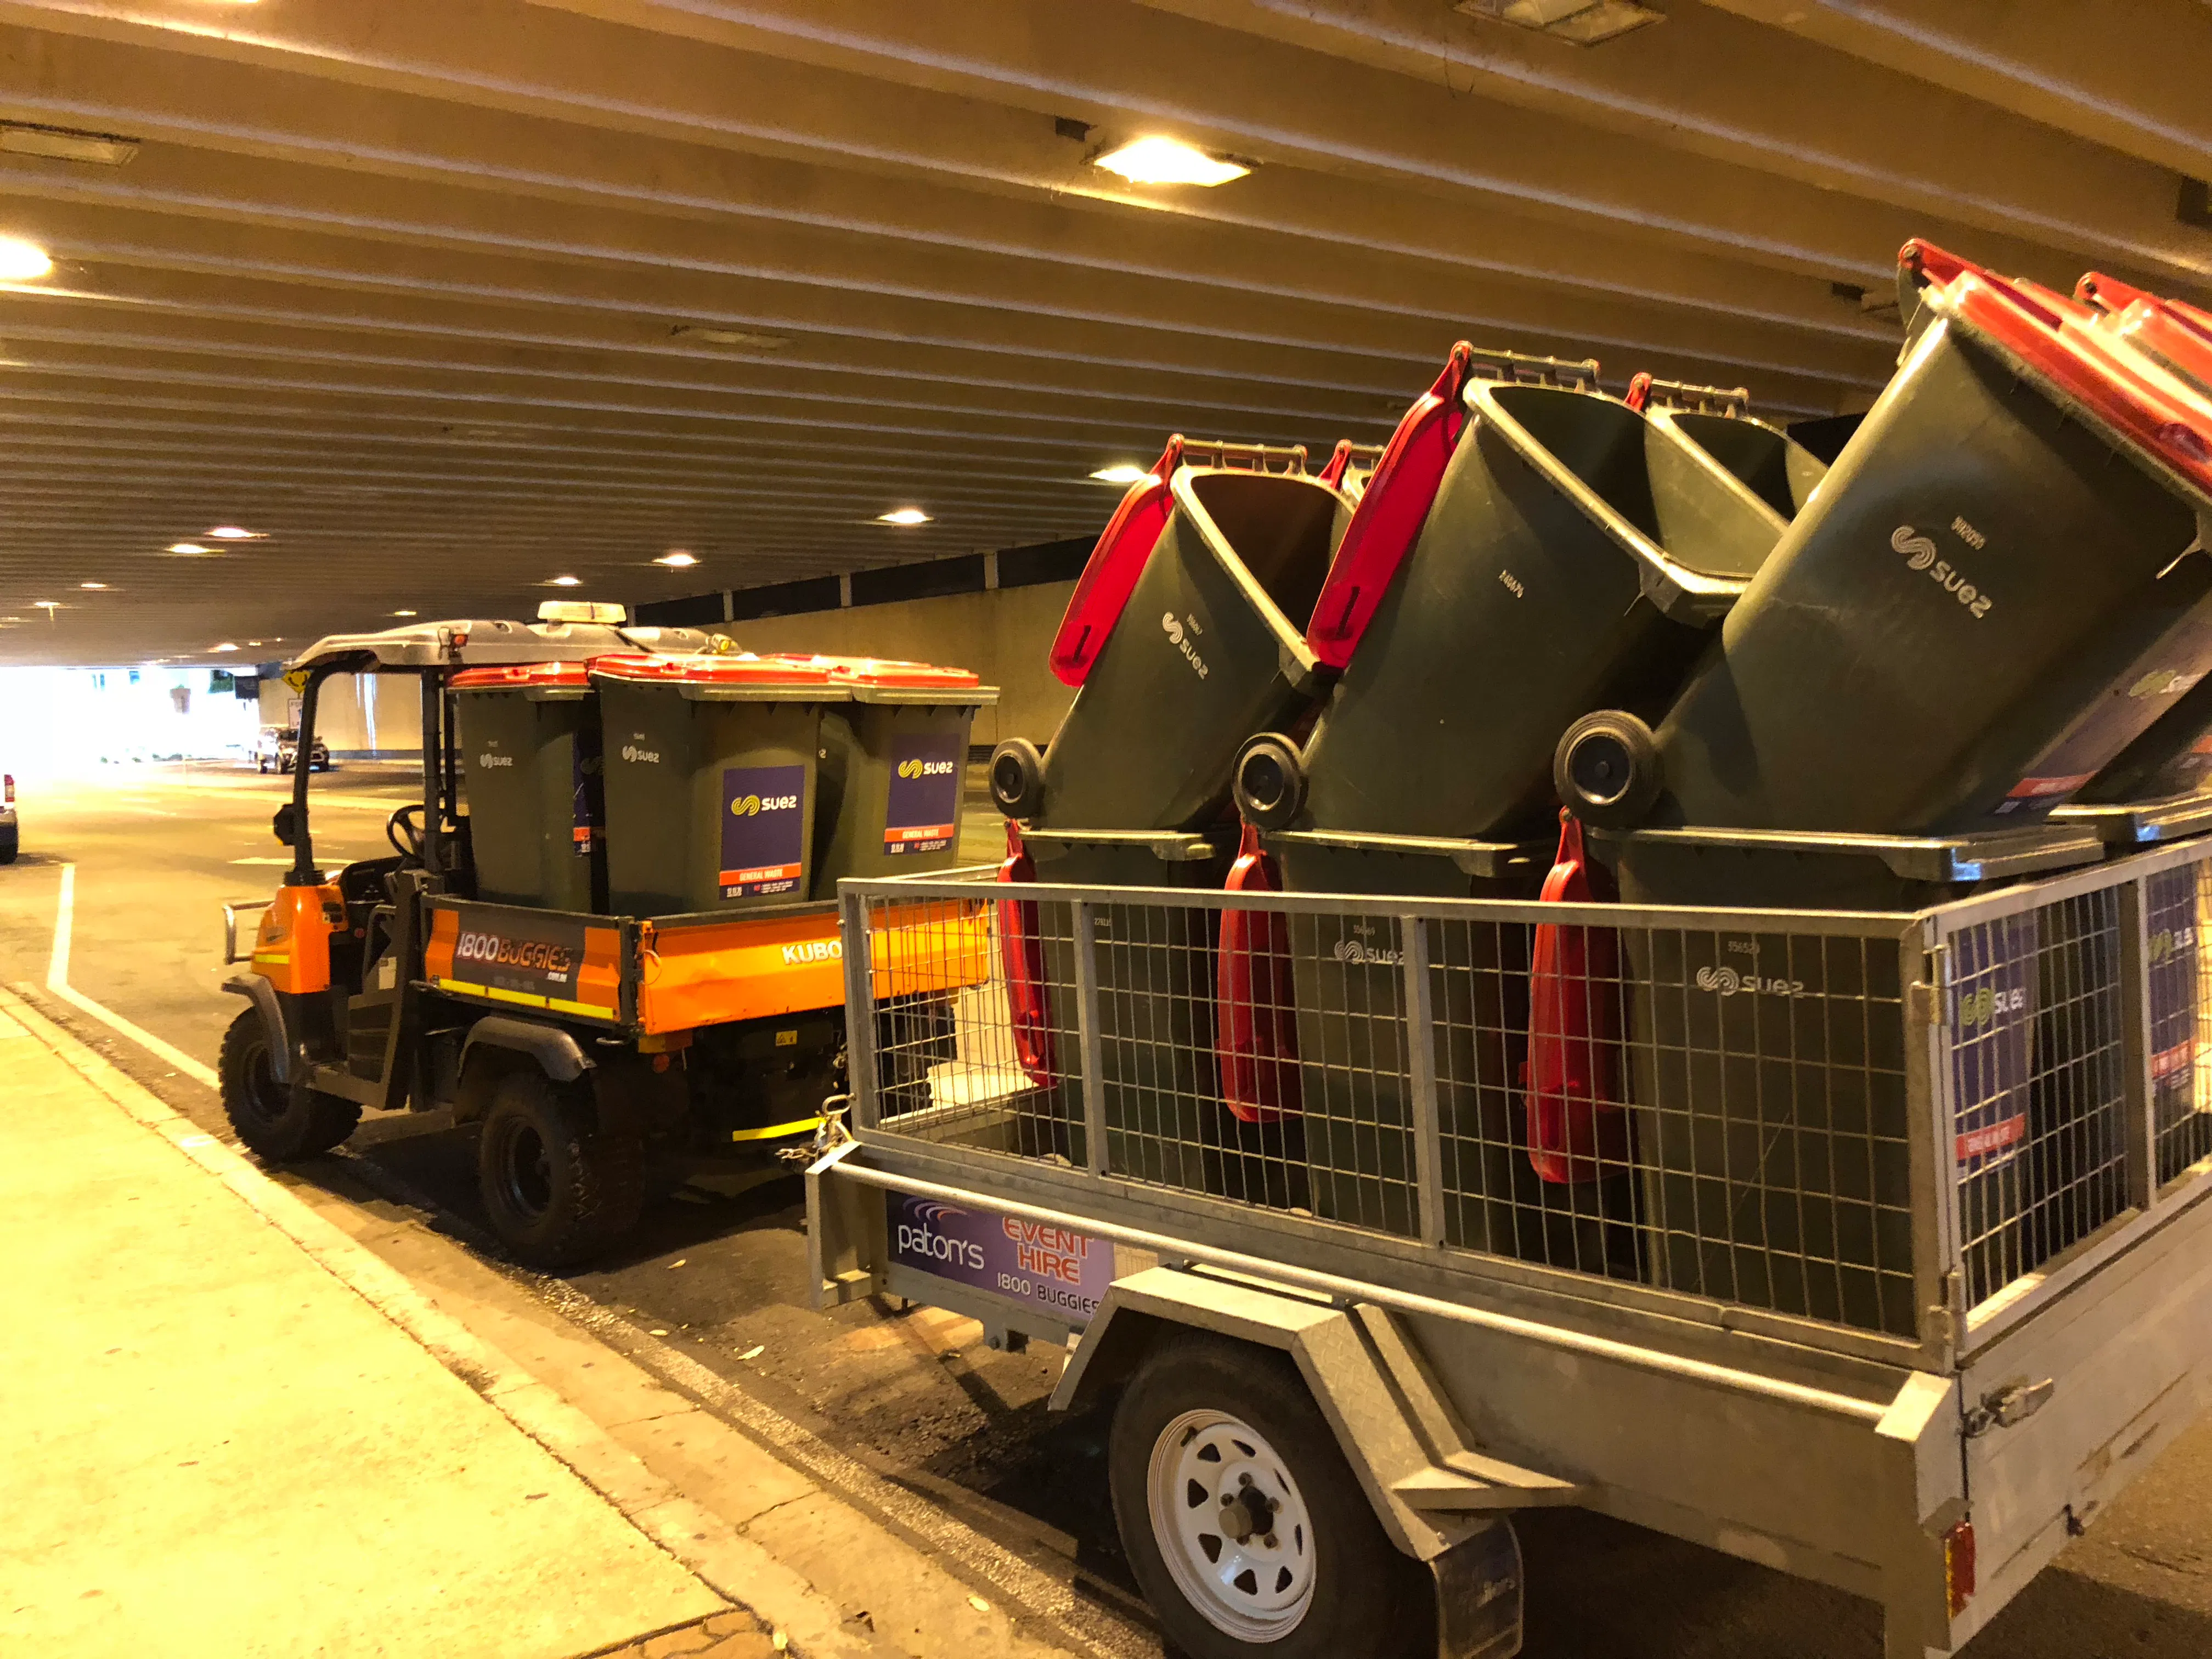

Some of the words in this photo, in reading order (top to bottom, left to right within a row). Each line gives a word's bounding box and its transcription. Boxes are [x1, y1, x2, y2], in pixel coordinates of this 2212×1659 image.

[1930, 561, 1992, 618] suez
[1180, 638, 1208, 680] suez
[493, 757, 512, 766] suez
[637, 750, 659, 763] suez
[923, 761, 953, 775] suez
[761, 795, 797, 811] suez
[782, 940, 843, 965] KUBO
[898, 1222, 985, 1269] paton's
[1002, 1216, 1094, 1260] EVENT
[1017, 1242, 1081, 1285] HIRE
[997, 1272, 1031, 1296] 1800
